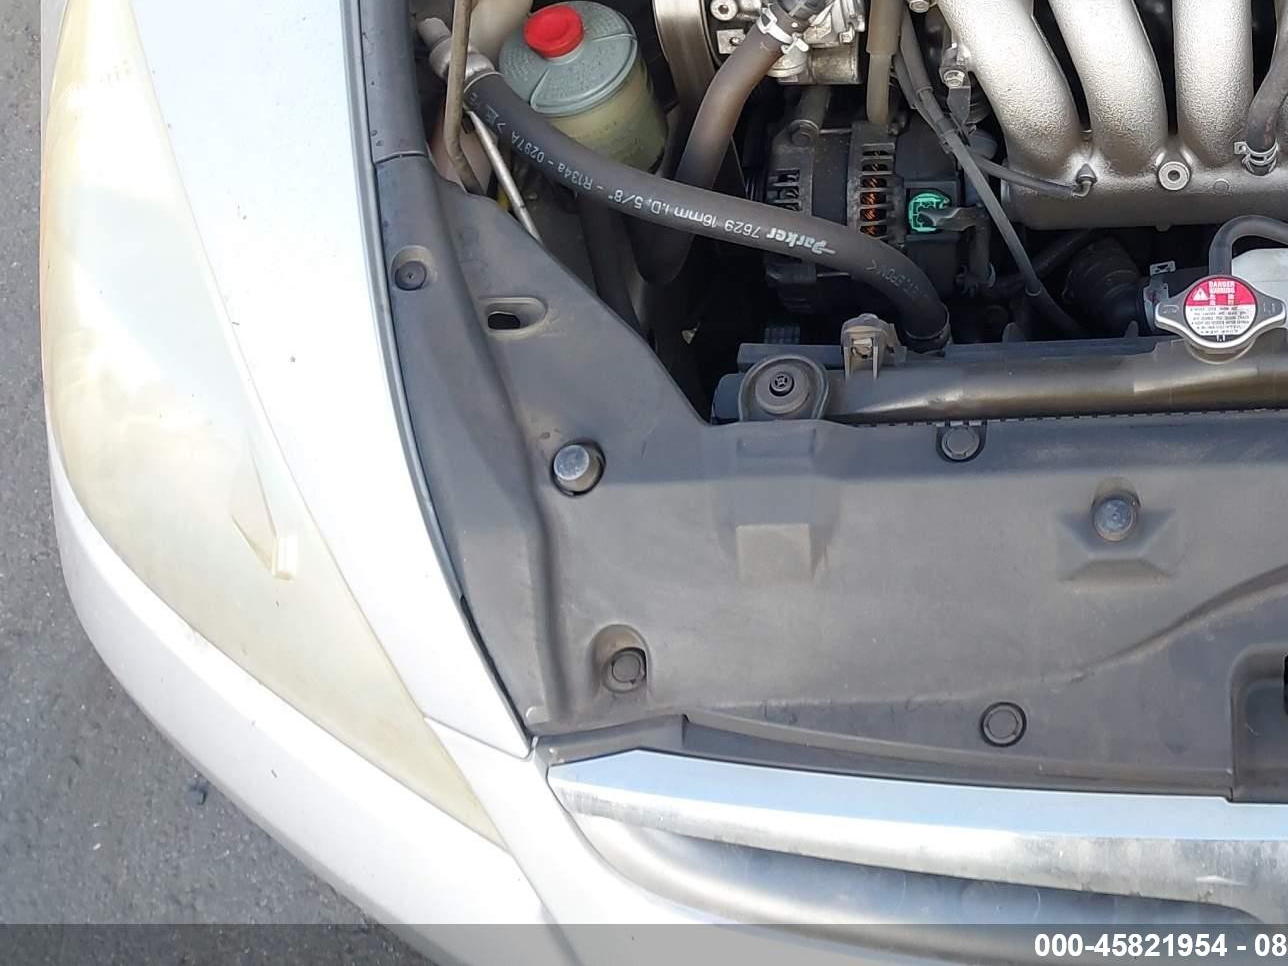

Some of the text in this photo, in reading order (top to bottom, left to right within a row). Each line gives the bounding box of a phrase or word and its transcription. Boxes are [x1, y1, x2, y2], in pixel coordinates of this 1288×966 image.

[557, 162, 594, 191] R134a
[724, 219, 761, 239] 7629
[766, 228, 836, 255] Parker
